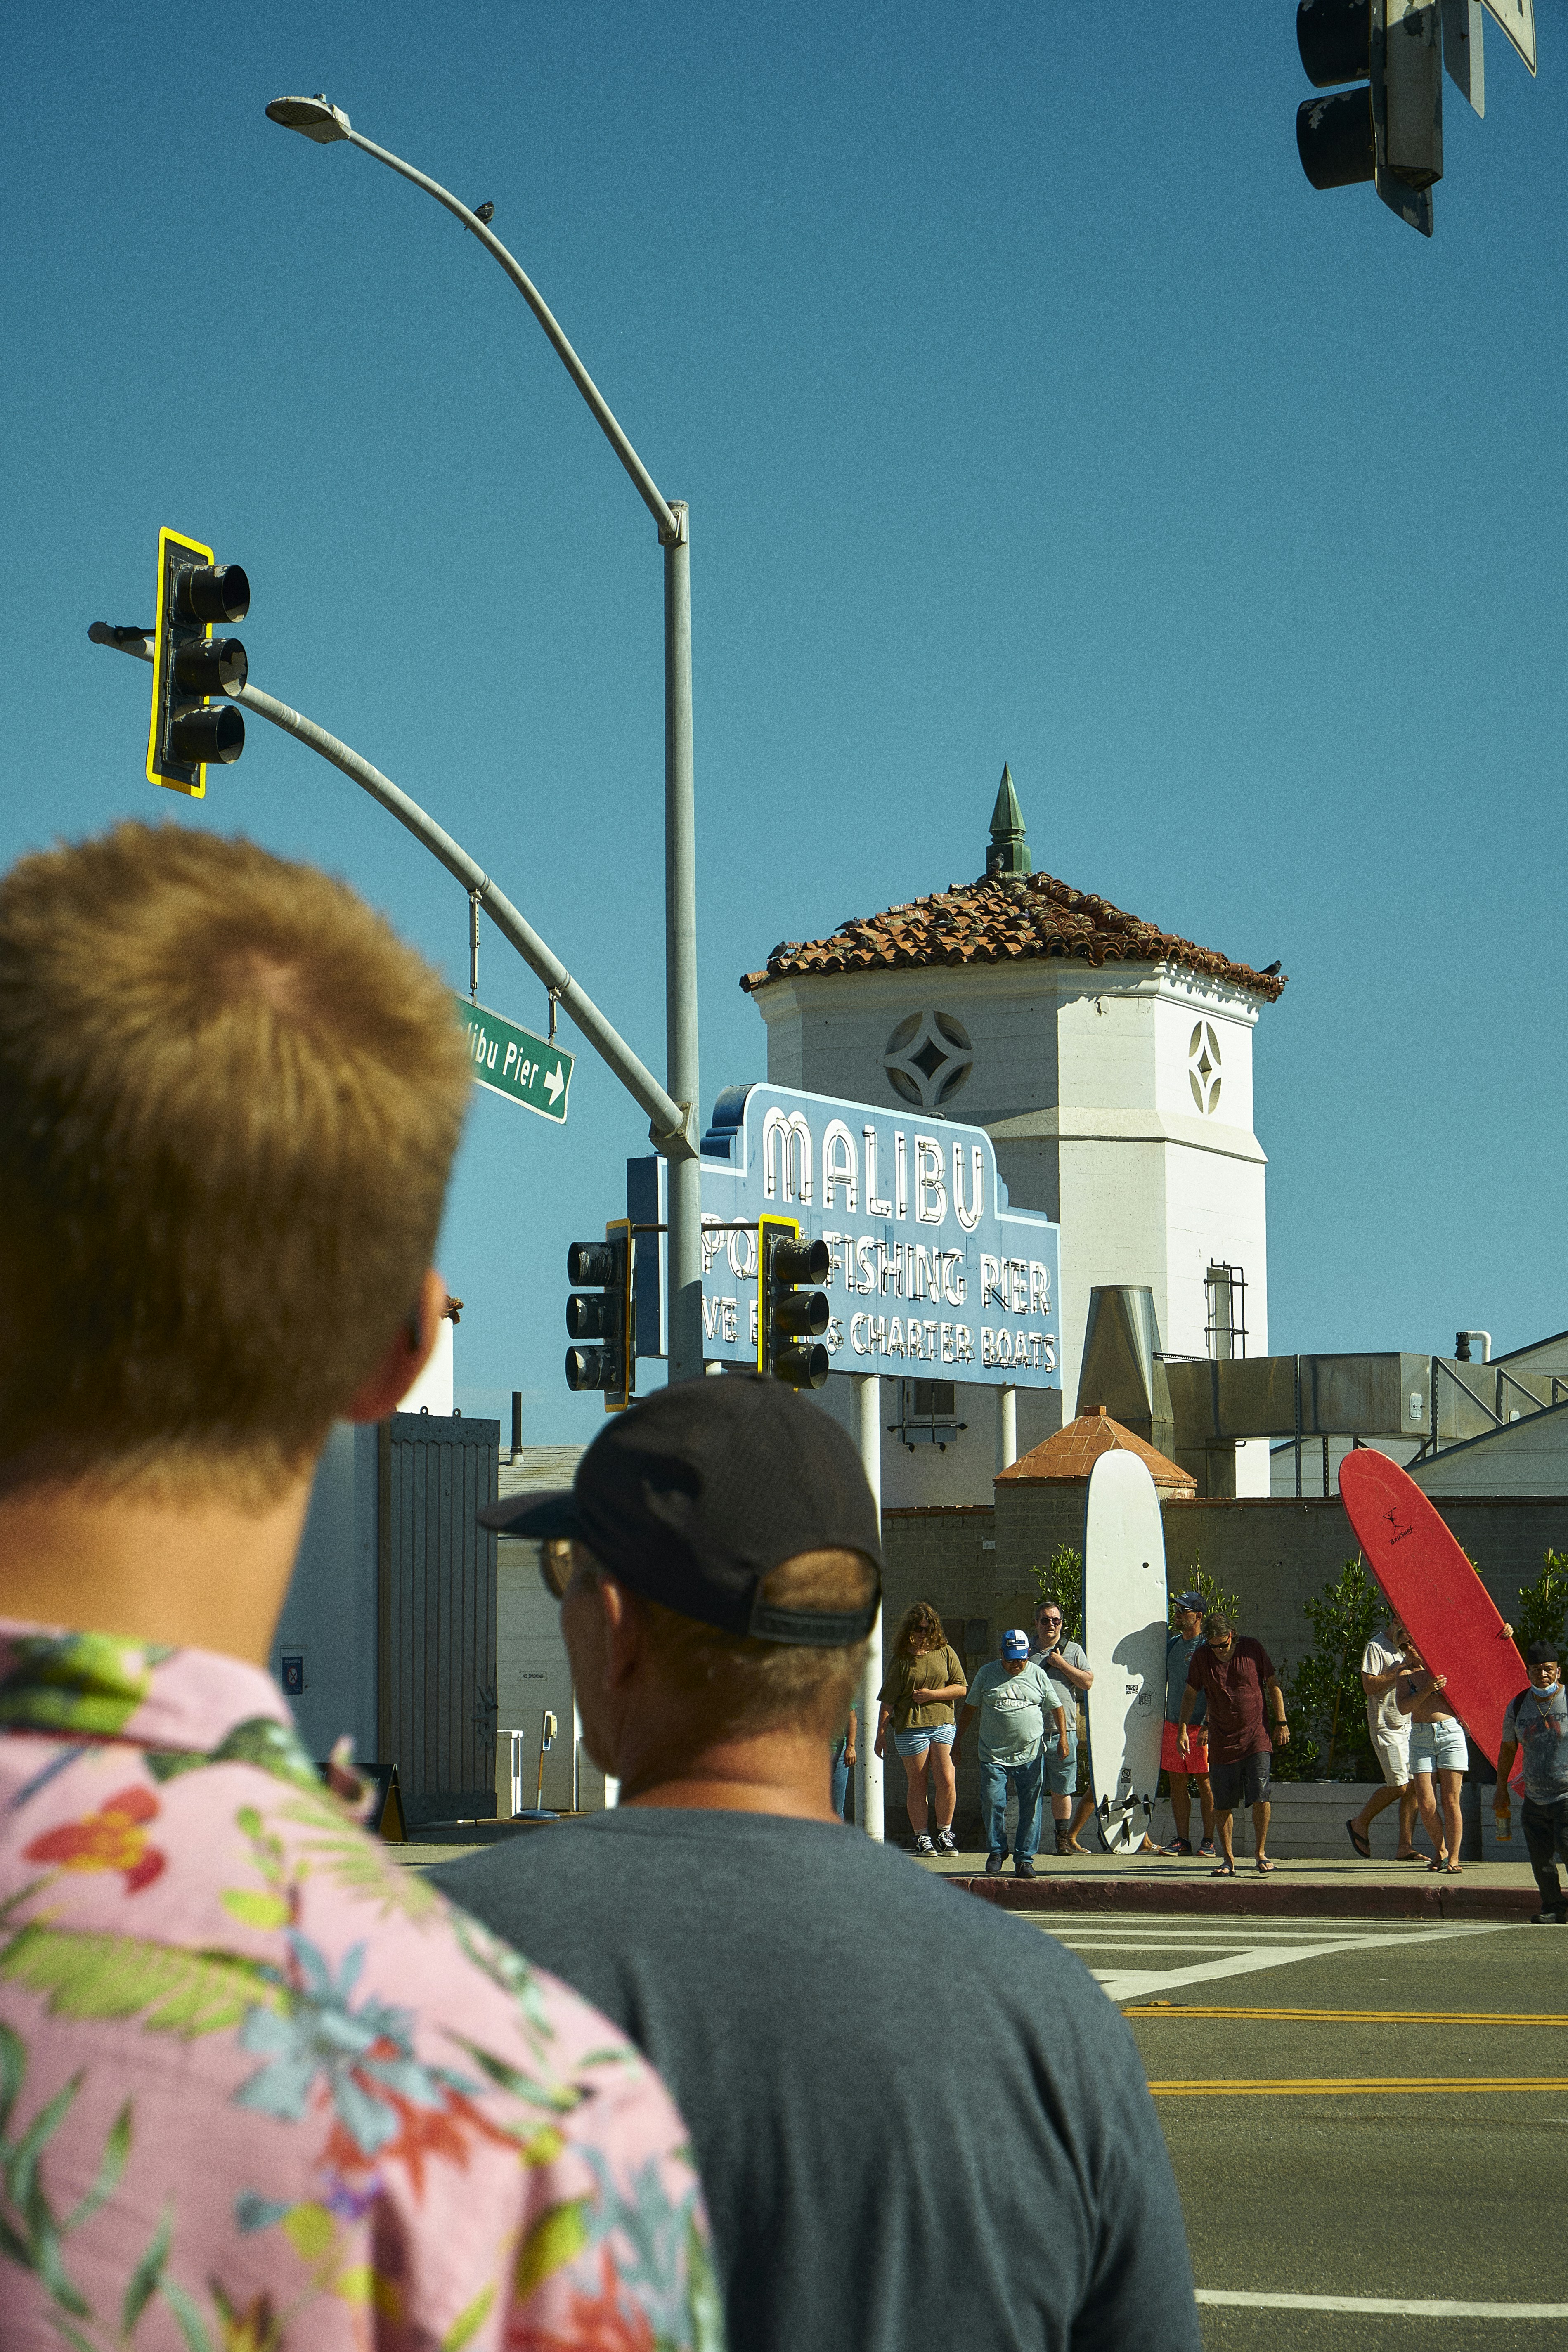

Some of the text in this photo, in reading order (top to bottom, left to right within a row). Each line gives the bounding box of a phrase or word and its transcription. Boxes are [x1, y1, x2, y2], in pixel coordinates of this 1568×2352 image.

[466, 1022, 539, 1088] libu Pier
[763, 1106, 983, 1232] MALIBU
[822, 1230, 967, 1306] FISHING
[980, 1253, 1051, 1316] PIER
[702, 1295, 740, 1343] VE
[826, 1316, 844, 1355] &
[851, 1312, 975, 1364] CHARTER
[981, 1326, 1059, 1372] BOATS
[995, 1698, 1029, 1707] adidas
